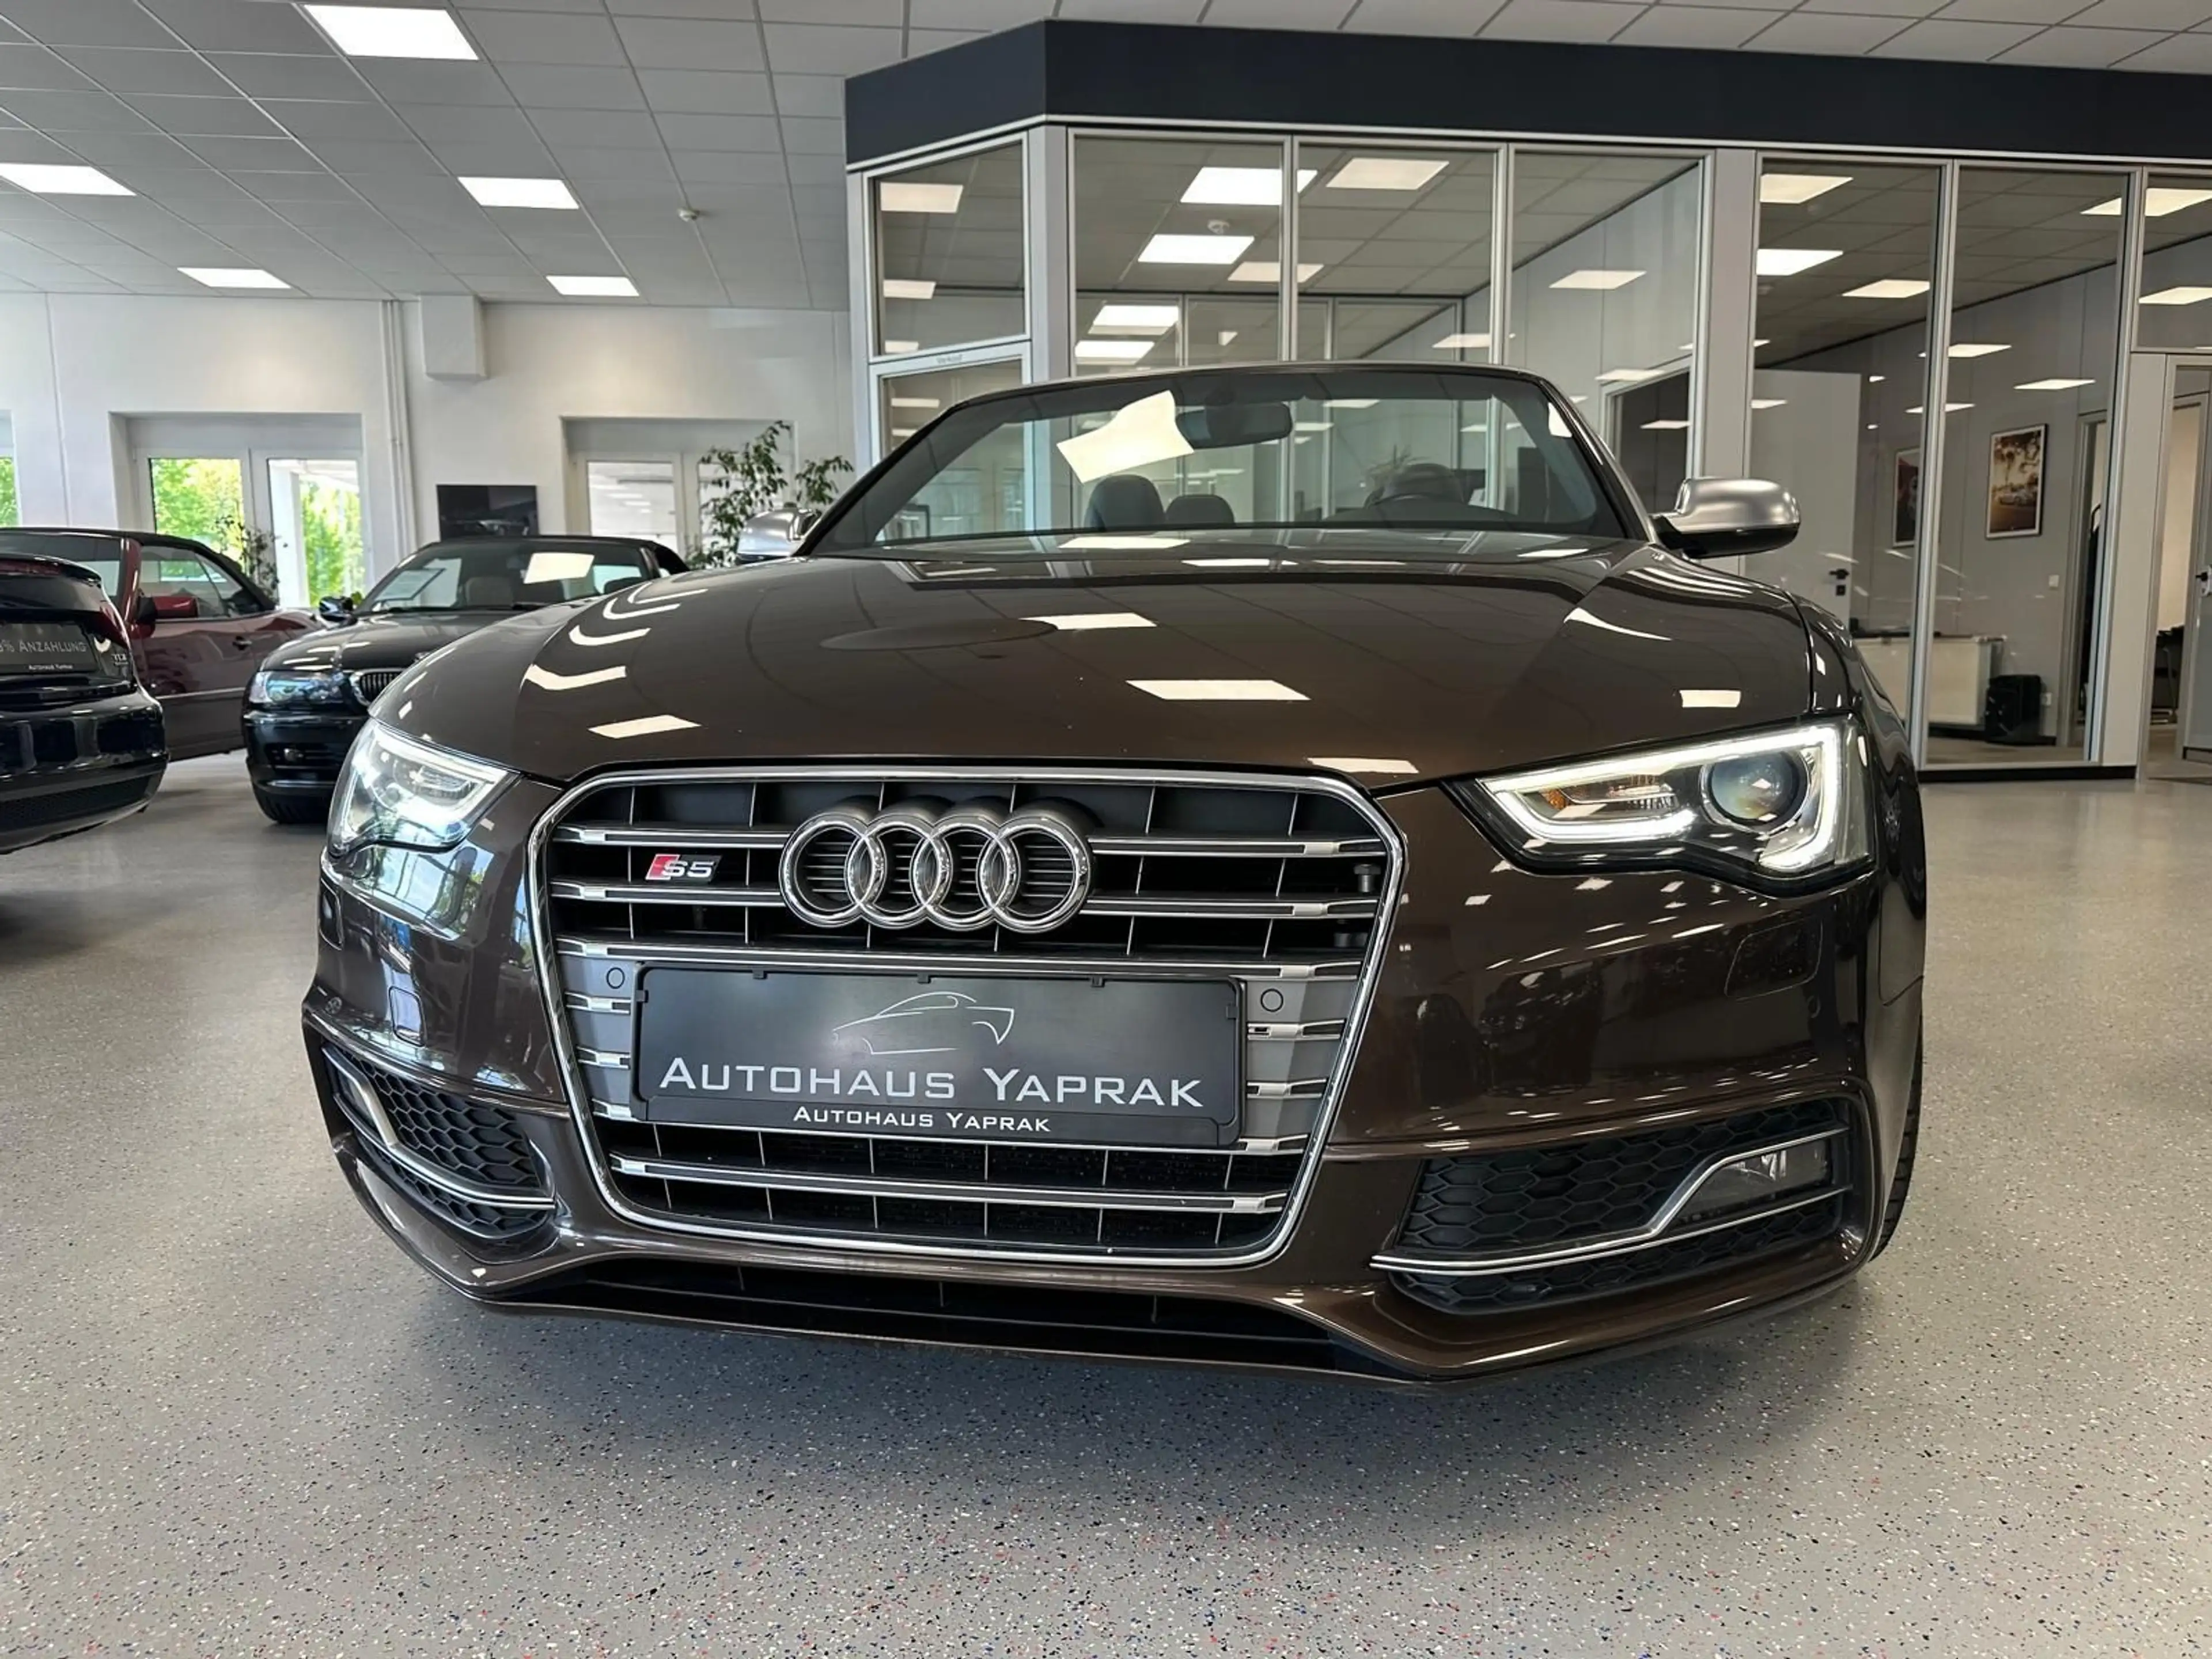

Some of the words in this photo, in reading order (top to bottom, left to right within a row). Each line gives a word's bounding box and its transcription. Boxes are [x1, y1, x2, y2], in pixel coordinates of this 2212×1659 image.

[662, 861, 714, 877] S5
[659, 1057, 955, 1099] AUTOHAUS
[983, 1068, 1203, 1107] YAPRAK
[793, 1105, 933, 1128] AUTOHAUS
[946, 1112, 1051, 1132] YAPRAK
